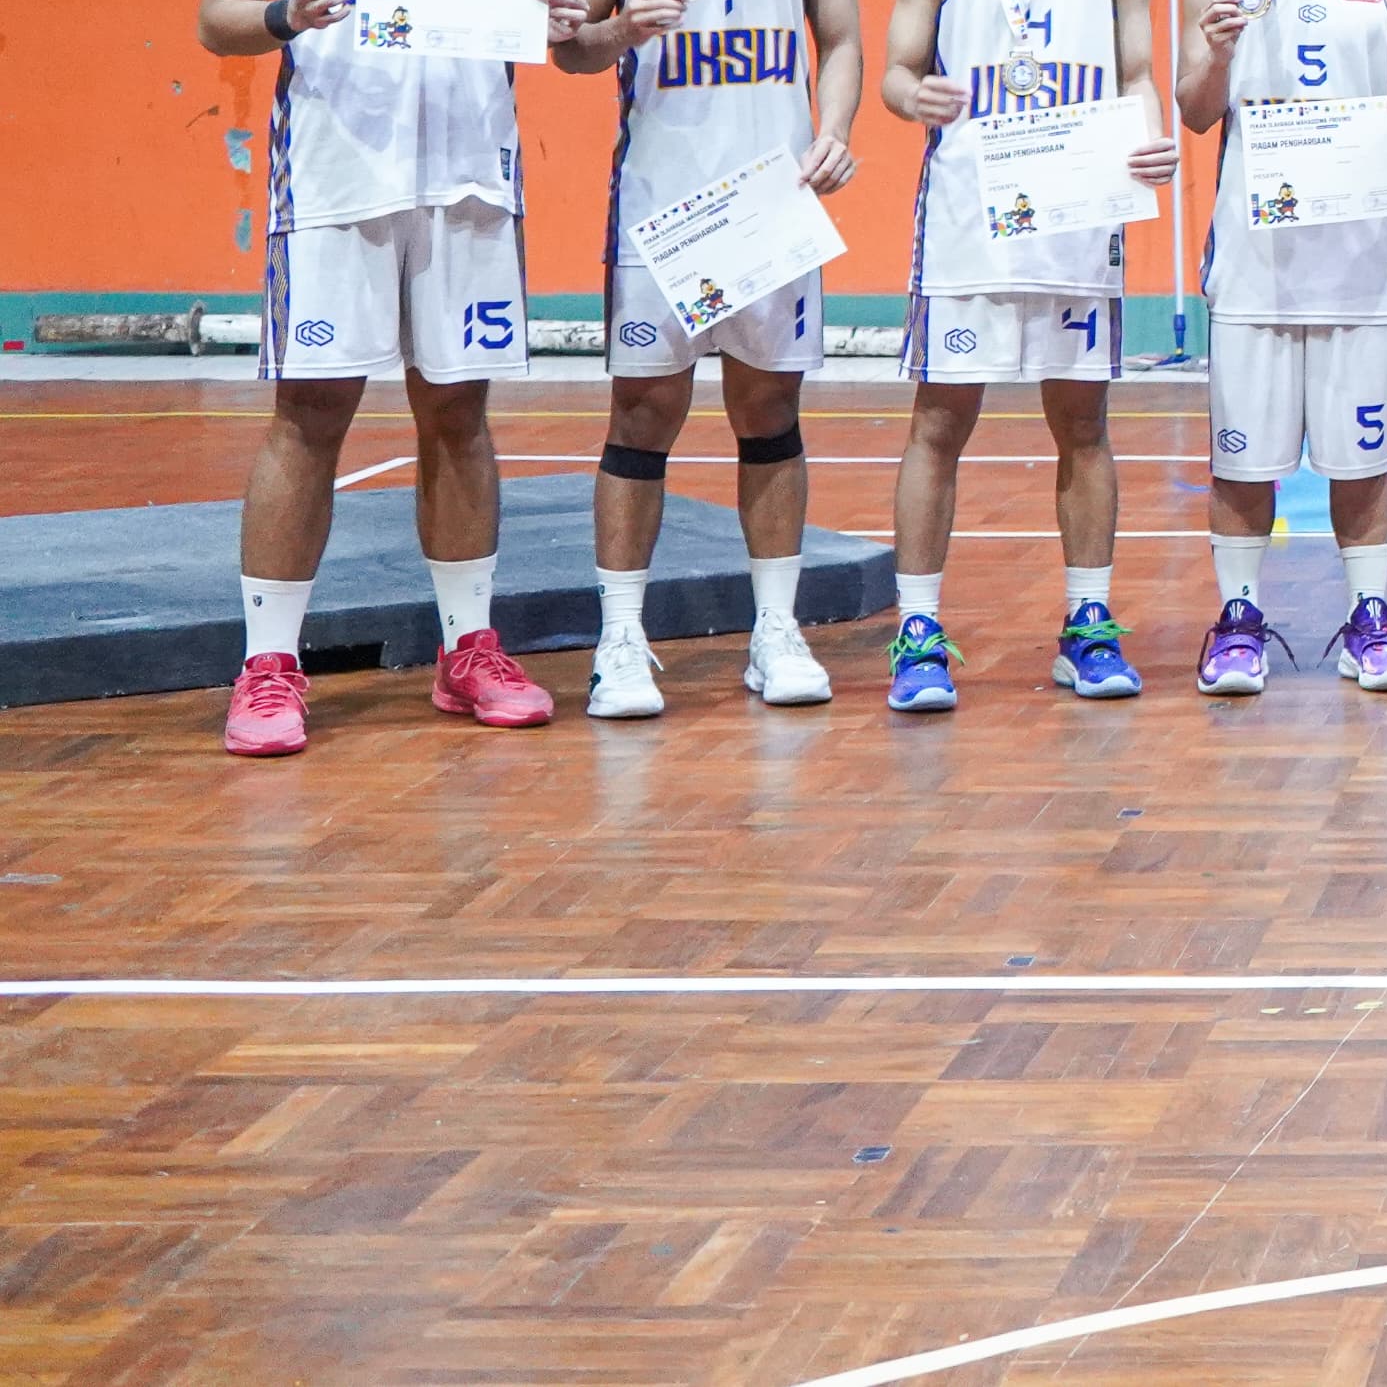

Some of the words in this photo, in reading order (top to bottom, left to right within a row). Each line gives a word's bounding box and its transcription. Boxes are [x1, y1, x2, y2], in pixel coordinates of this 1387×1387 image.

[657, 27, 797, 91] UKSW
[1297, 44, 1328, 87] 5
[984, 151, 1011, 162] PIAGAM
[1013, 143, 1065, 159] PENGHARGAAN
[1250, 141, 1278, 151] PIAGAM
[1280, 136, 1332, 149] PENGHARGAAN
[463, 300, 514, 351] 15
[1061, 307, 1098, 354] 4
[1355, 403, 1387, 452] 5
